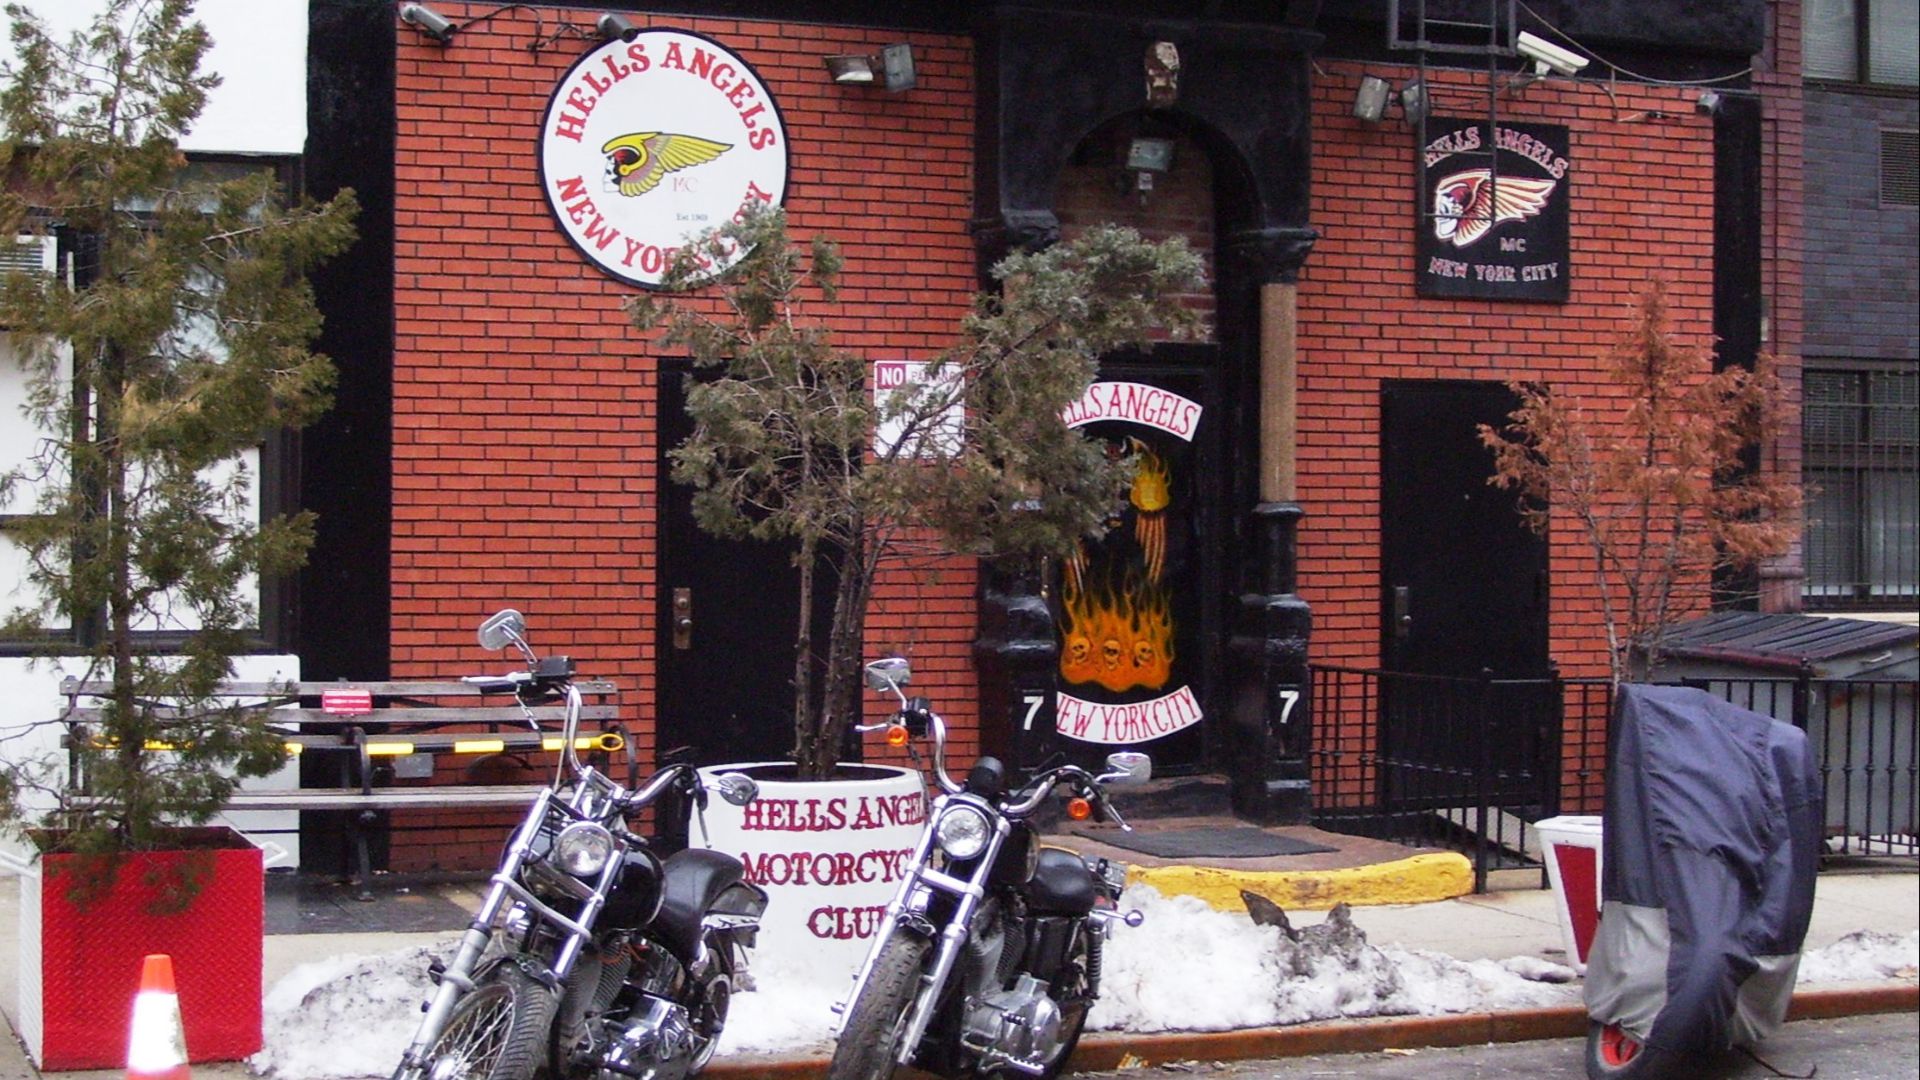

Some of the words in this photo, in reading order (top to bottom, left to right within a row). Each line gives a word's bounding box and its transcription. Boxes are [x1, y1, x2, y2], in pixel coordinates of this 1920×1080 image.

[555, 43, 651, 142] HELLS
[660, 41, 776, 151] ANGELS
[556, 175, 621, 251] NEW
[1500, 237, 1526, 252] MC
[1428, 256, 1468, 279] NEW
[1475, 263, 1517, 282] YORK
[1522, 262, 1558, 282] CITY
[881, 367, 904, 386] NO
[1058, 385, 1103, 426] ELLS
[1106, 384, 1198, 436] ANGELS
[1023, 695, 1044, 731] 7
[1100, 703, 1154, 742] YORK
[1152, 687, 1198, 733] CITY
[1279, 690, 1299, 723] 7
[740, 798, 847, 832] HELLS
